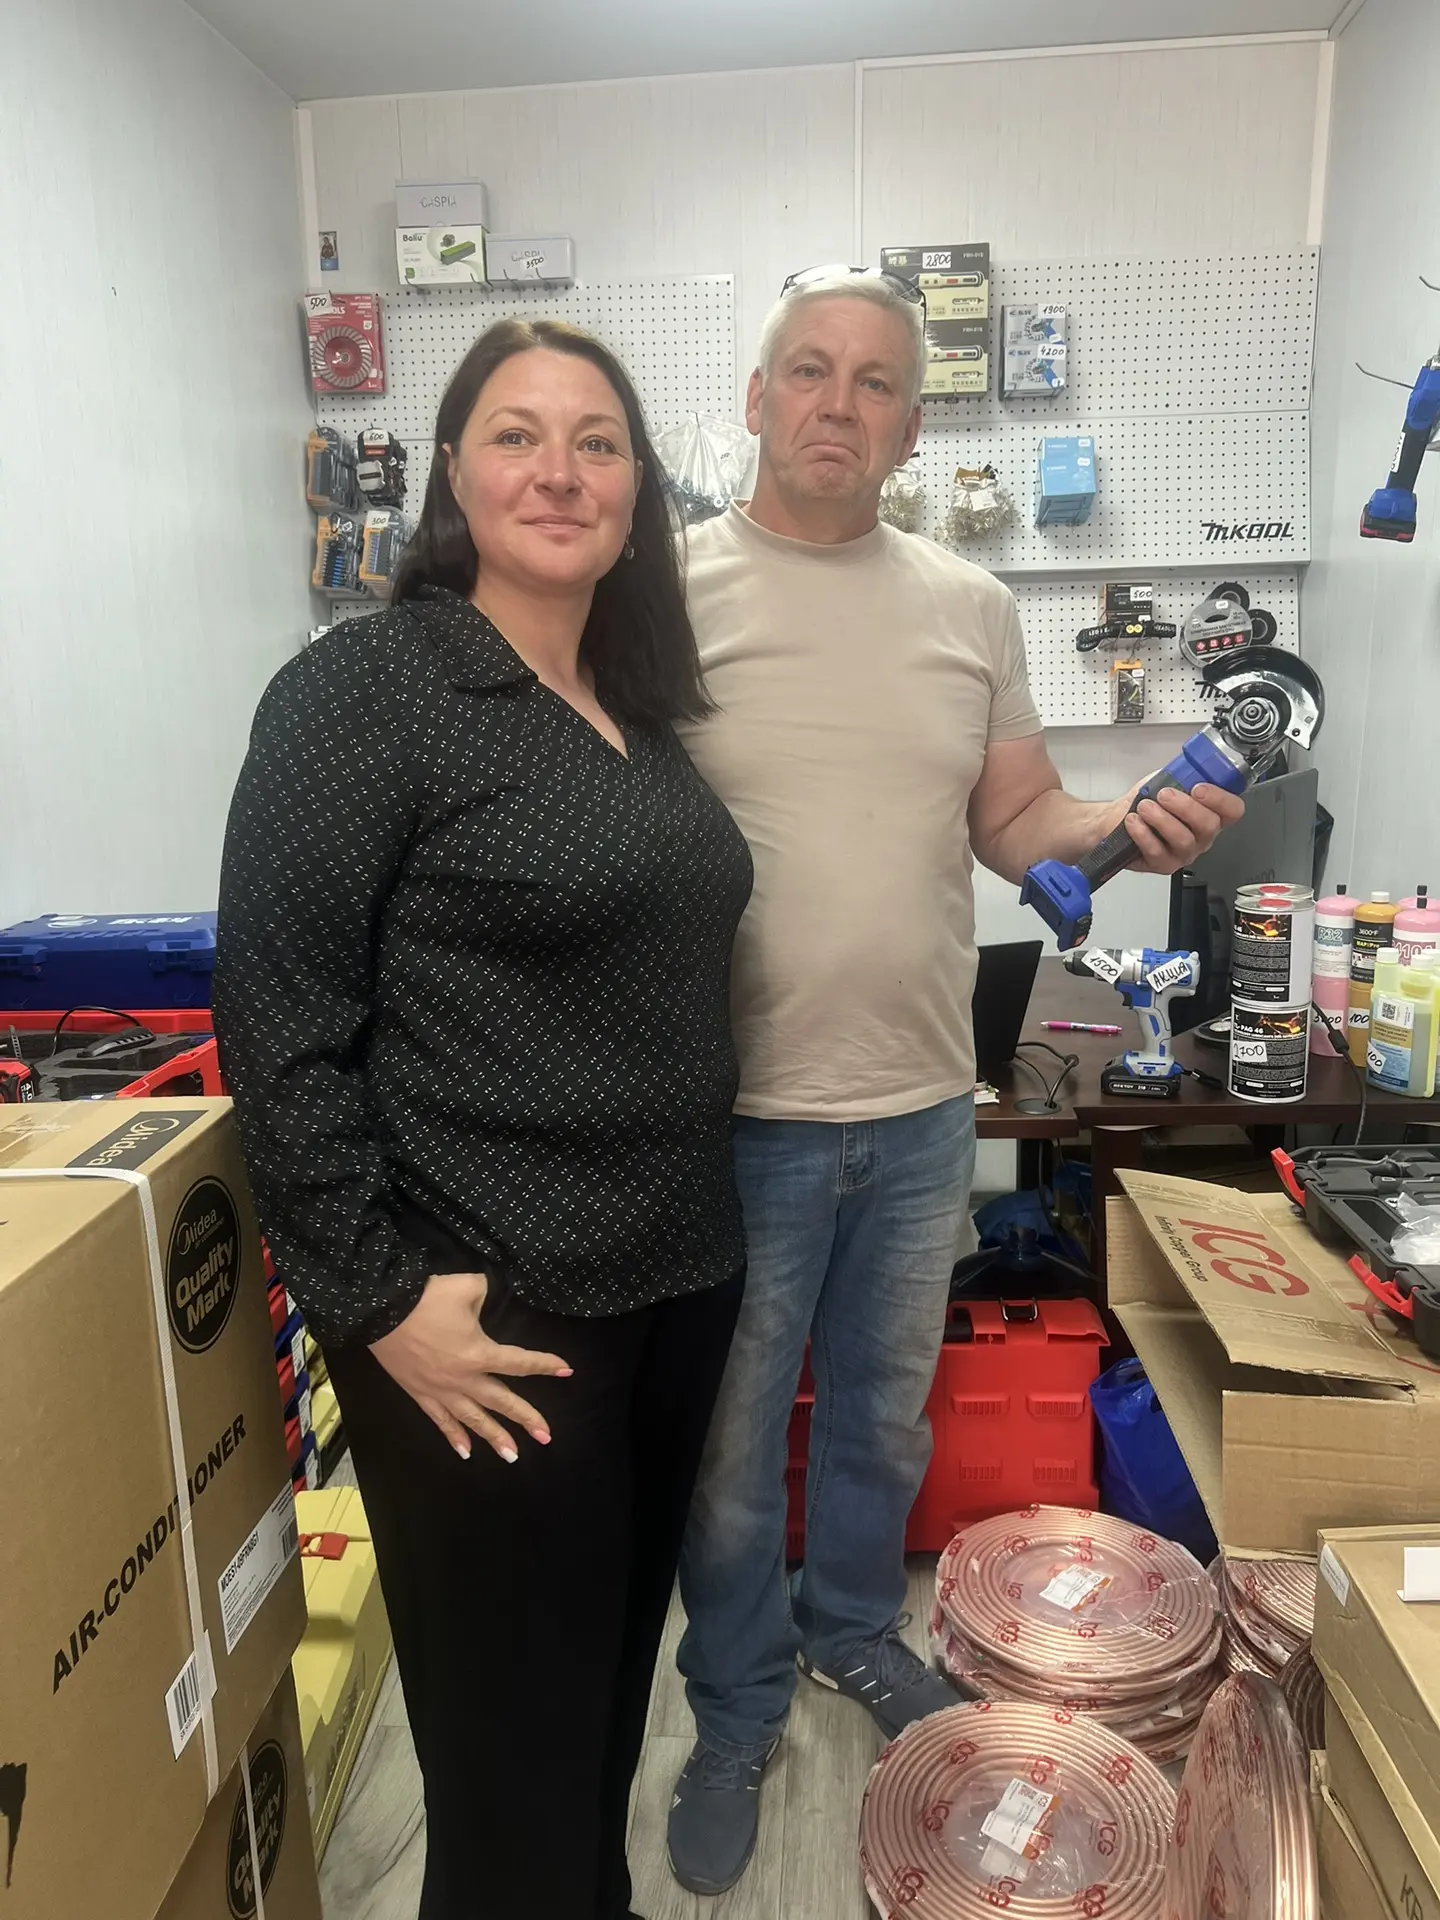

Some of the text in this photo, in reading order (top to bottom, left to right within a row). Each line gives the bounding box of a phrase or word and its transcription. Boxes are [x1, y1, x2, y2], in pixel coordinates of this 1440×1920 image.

[402, 233, 423, 242] Ballu
[925, 253, 951, 268] 2800
[310, 297, 327, 310] 500
[1043, 305, 1066, 314] 1900
[371, 516, 387, 525] 300
[1133, 590, 1153, 599] 500
[1318, 926, 1343, 942] R32
[1090, 956, 1119, 977] 1500
[1153, 961, 1189, 989] АКЦИЯ
[85, 1117, 180, 1166] Midea
[176, 1208, 218, 1256] Midea
[1168, 1235, 1193, 1262] Copper
[1185, 1260, 1209, 1284] Group
[1178, 1218, 1310, 1297] ICG
[175, 1236, 234, 1309] Quality
[186, 1272, 232, 1333] Mark
[1097, 1820, 1118, 1857] ICG
